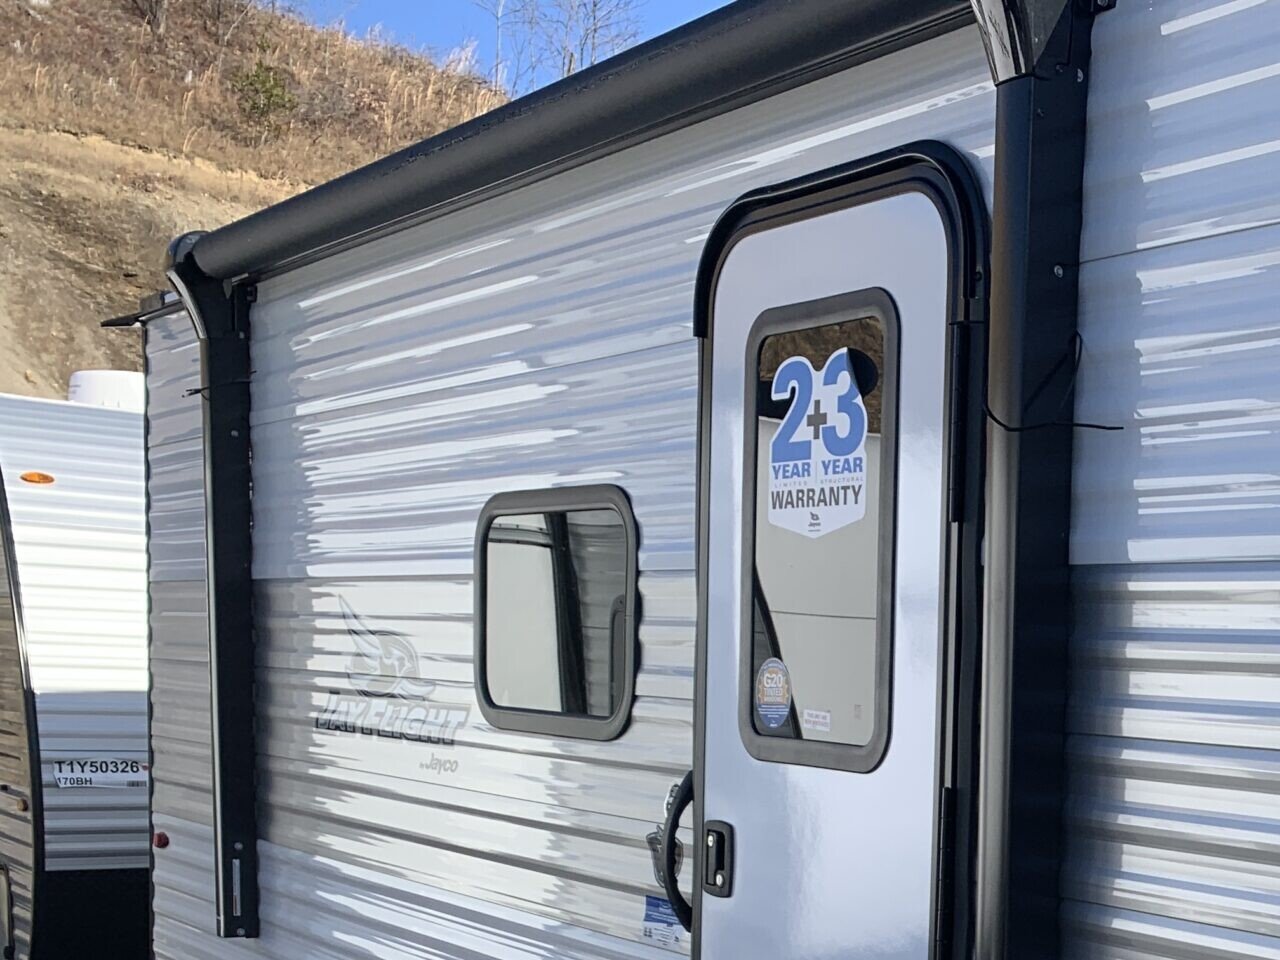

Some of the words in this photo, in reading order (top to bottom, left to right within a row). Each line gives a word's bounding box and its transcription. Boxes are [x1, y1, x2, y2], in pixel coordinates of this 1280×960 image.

[772, 462, 811, 480] YEAR
[821, 457, 863, 475] YEAR
[774, 480, 808, 489] LIMITED
[820, 476, 864, 485] STRUCTURAL
[771, 484, 862, 510] WARRANTY
[54, 760, 140, 774] T1Y50326
[57, 777, 93, 786] 170BH
